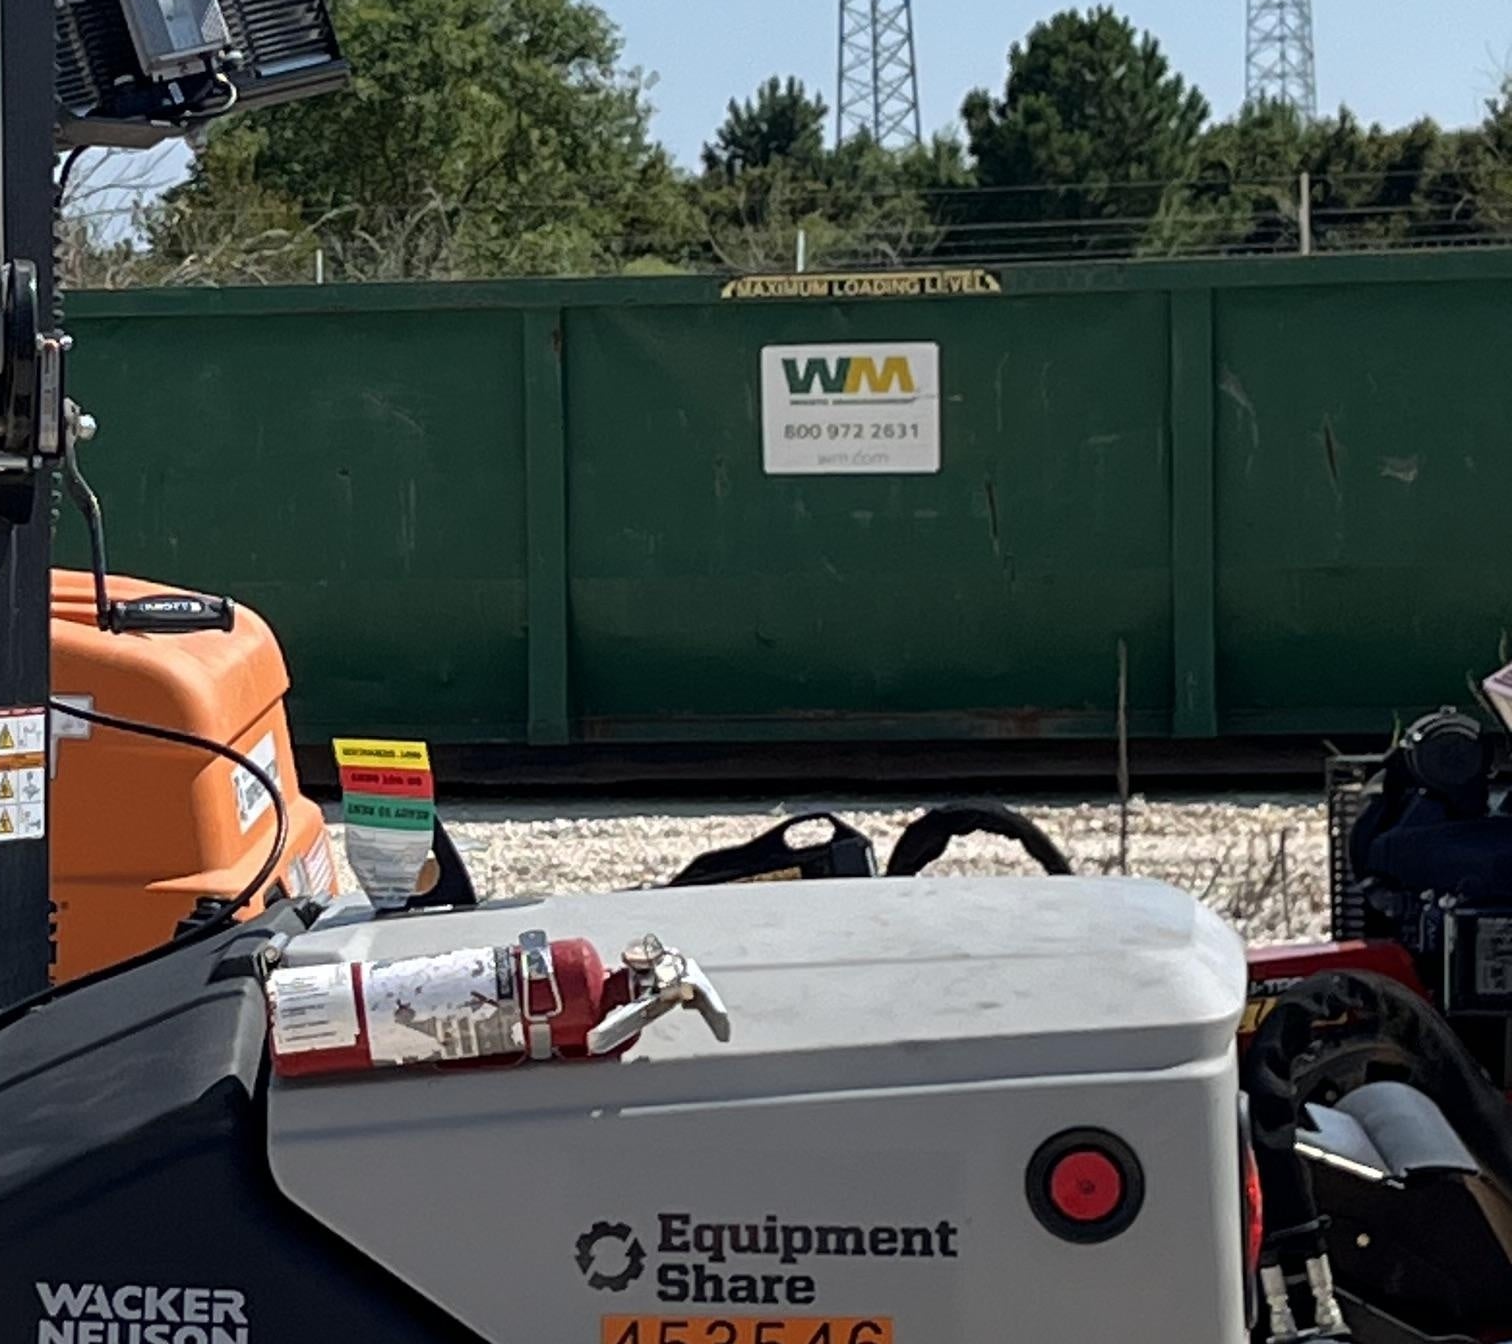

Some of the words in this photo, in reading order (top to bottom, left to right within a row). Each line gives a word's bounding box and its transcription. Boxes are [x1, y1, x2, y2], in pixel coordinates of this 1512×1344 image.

[832, 276, 919, 297] LOADING
[781, 356, 915, 394] WM
[826, 423, 864, 440] 972
[871, 423, 920, 440] 2631
[657, 1213, 958, 1264] Equipment
[35, 1282, 248, 1324] WACKER
[657, 1263, 816, 1304] Share
